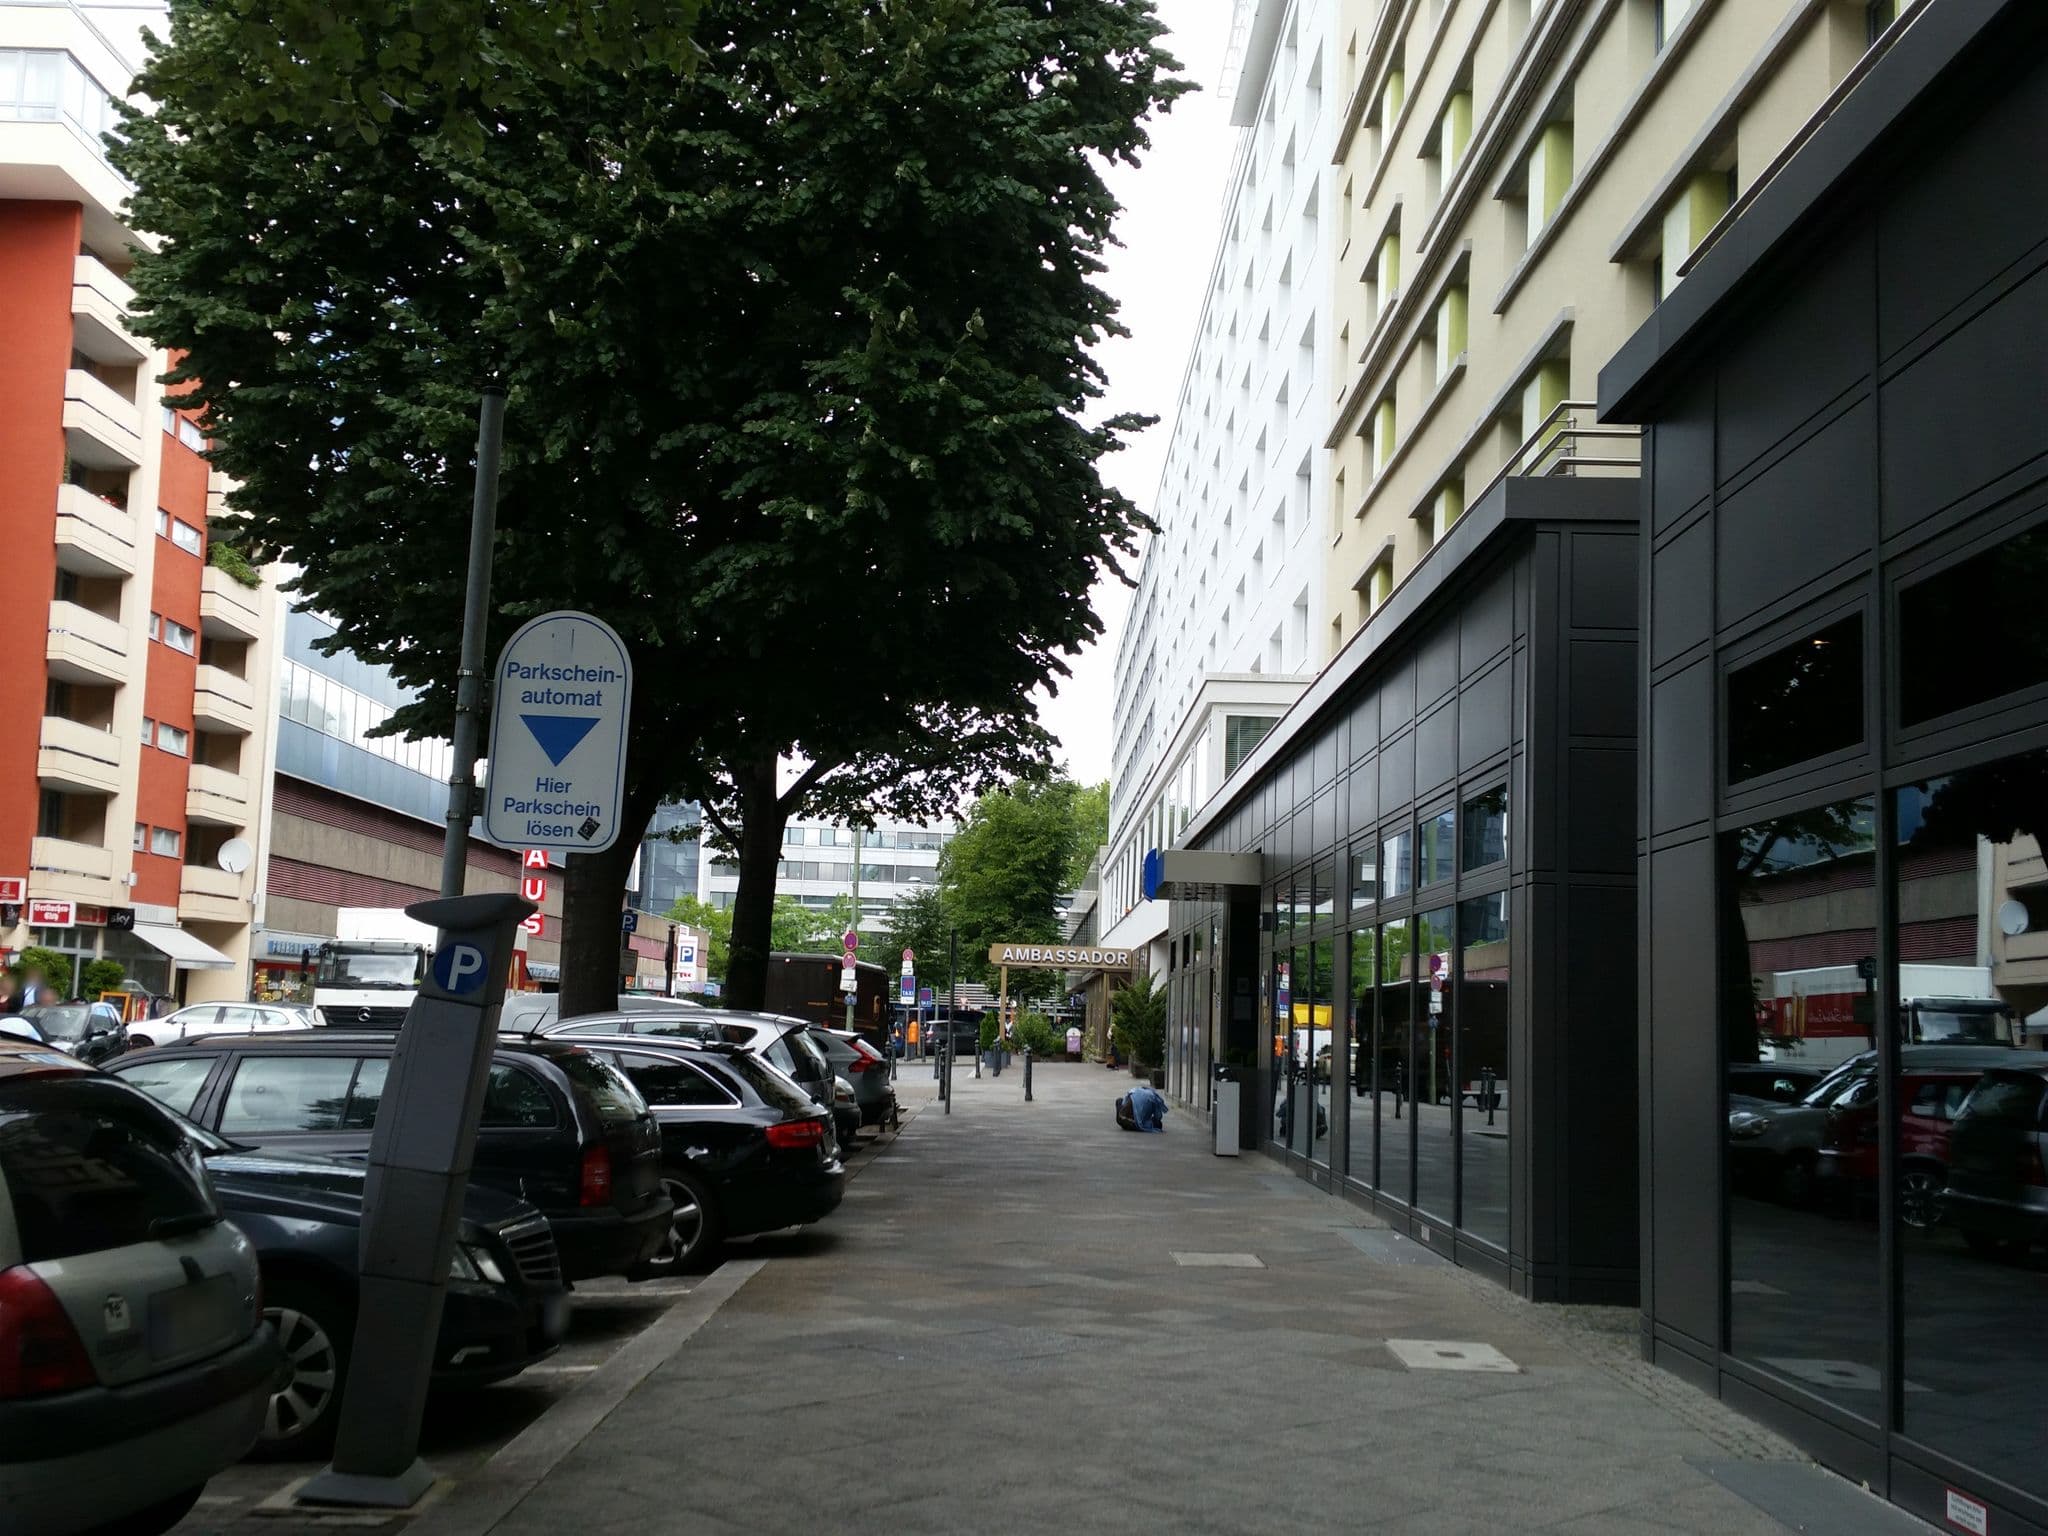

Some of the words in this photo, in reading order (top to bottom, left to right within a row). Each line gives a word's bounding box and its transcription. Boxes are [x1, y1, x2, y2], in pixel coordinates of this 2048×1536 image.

[507, 661, 623, 683] Parkschein-
[521, 688, 602, 707] automat
[536, 777, 572, 793] Hier
[503, 797, 601, 817] Parkschein
[526, 820, 573, 837] lösen
[111, 912, 131, 926] sky
[681, 947, 692, 962] P
[1002, 947, 1128, 965] AMBASSADOR
[447, 945, 483, 991] P
